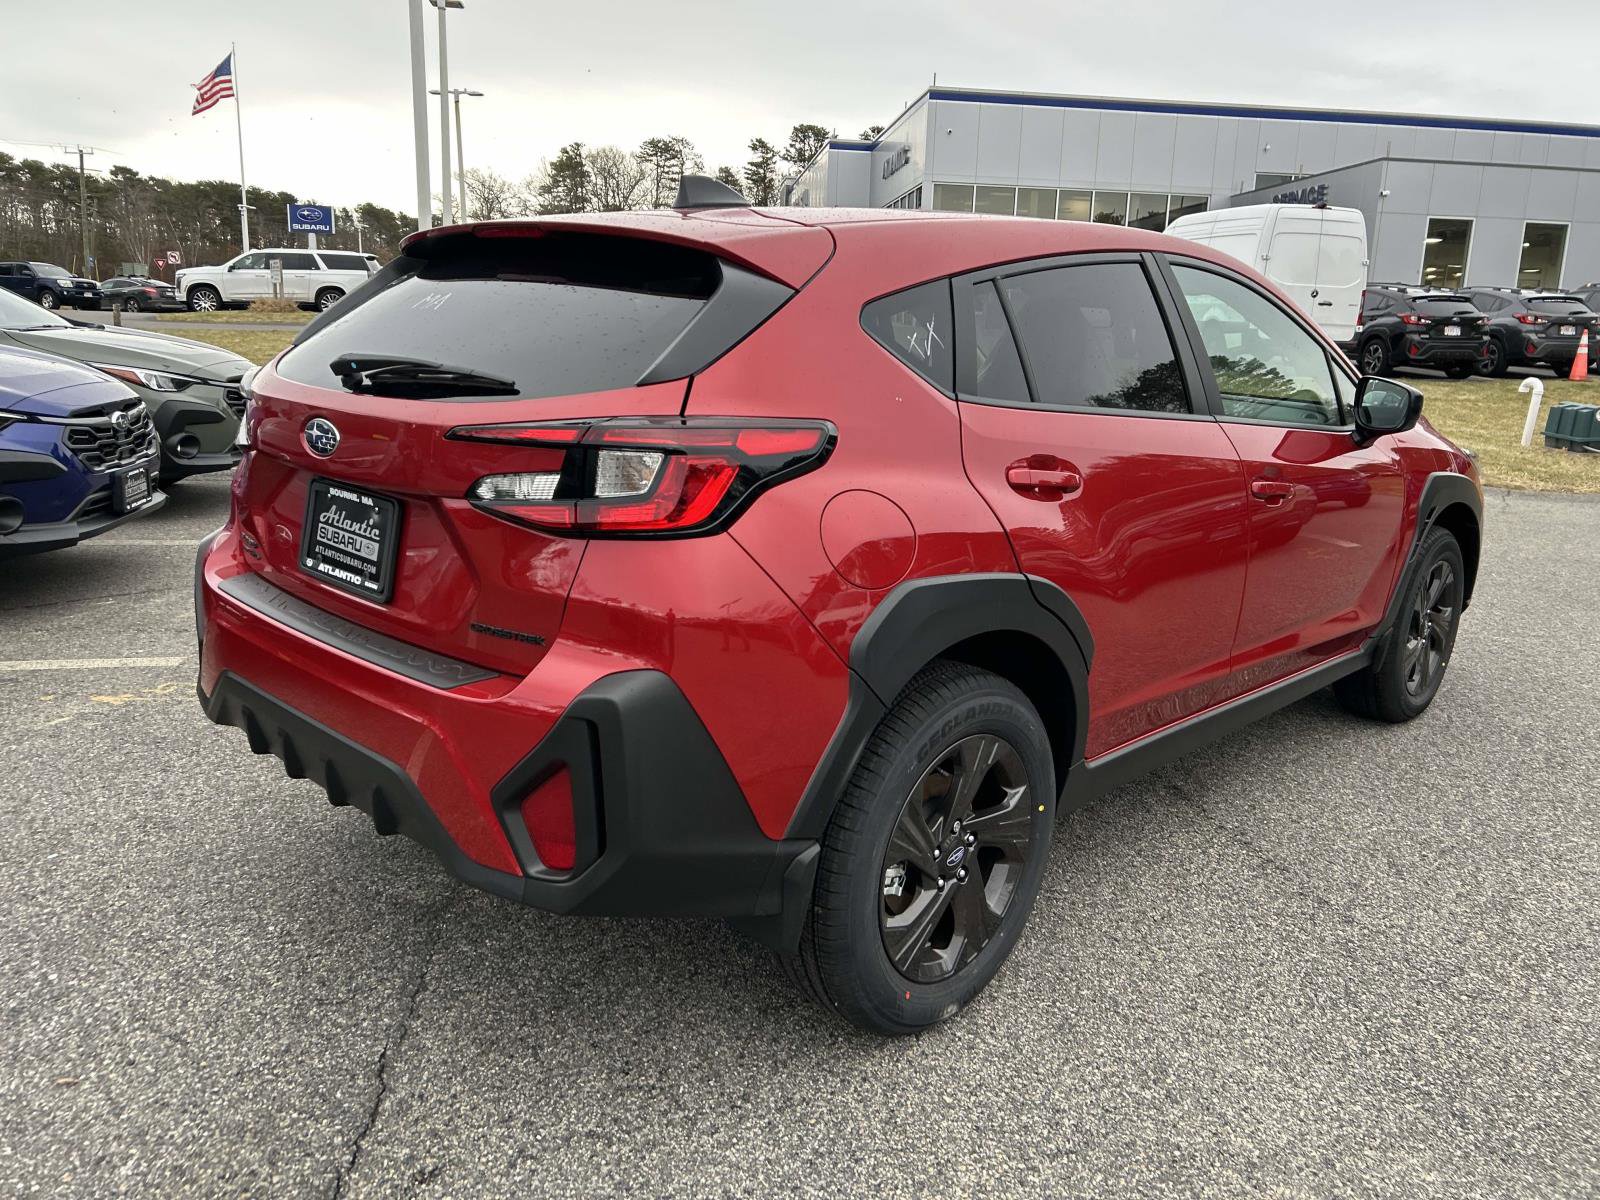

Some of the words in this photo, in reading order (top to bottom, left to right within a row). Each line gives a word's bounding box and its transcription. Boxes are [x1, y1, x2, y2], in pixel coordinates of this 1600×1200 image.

[292, 223, 330, 231] SUBARU
[320, 505, 381, 540] Atlantic
[319, 526, 362, 552] SUBARU
[315, 545, 377, 575] ATLANTICSUBARU.COM
[317, 563, 362, 585] ATLANTIC
